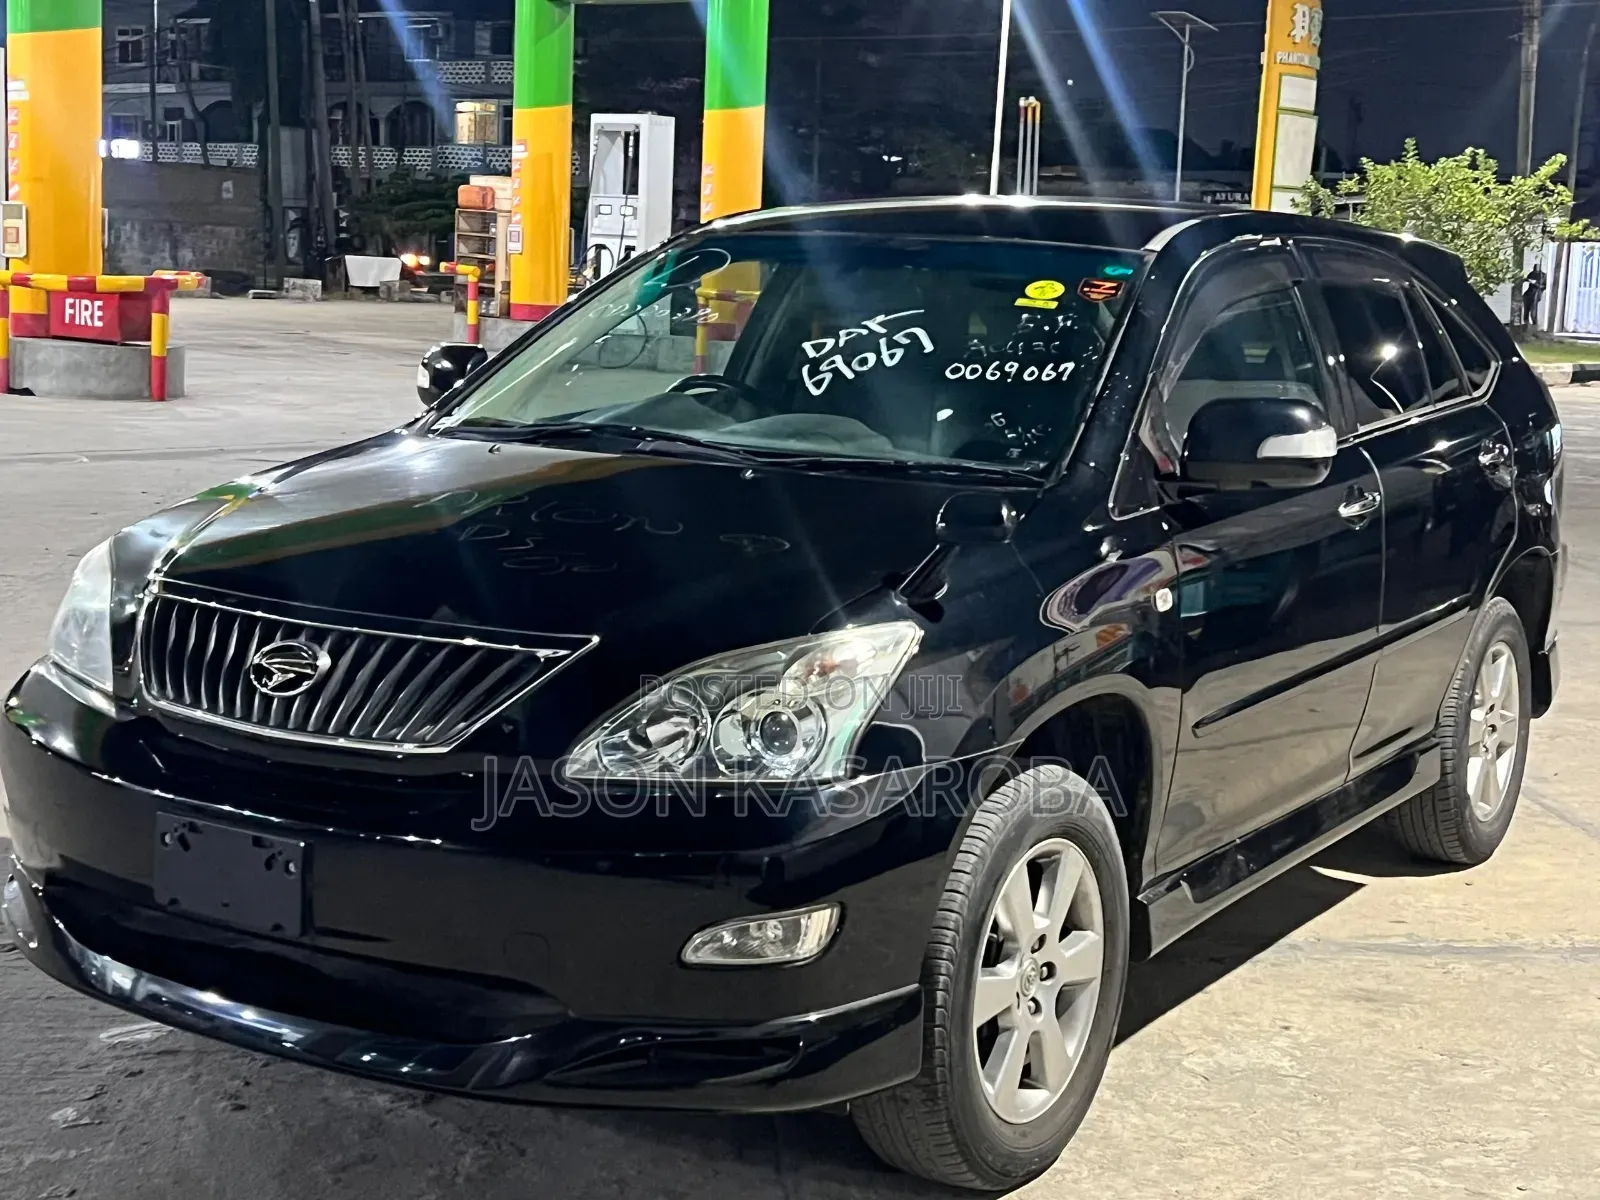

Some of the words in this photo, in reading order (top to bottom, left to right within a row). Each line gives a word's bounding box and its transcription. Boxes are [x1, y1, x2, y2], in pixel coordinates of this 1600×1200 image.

[65, 298, 103, 327] FIRE
[802, 327, 935, 396] 69067
[945, 361, 1075, 382] 0069067
